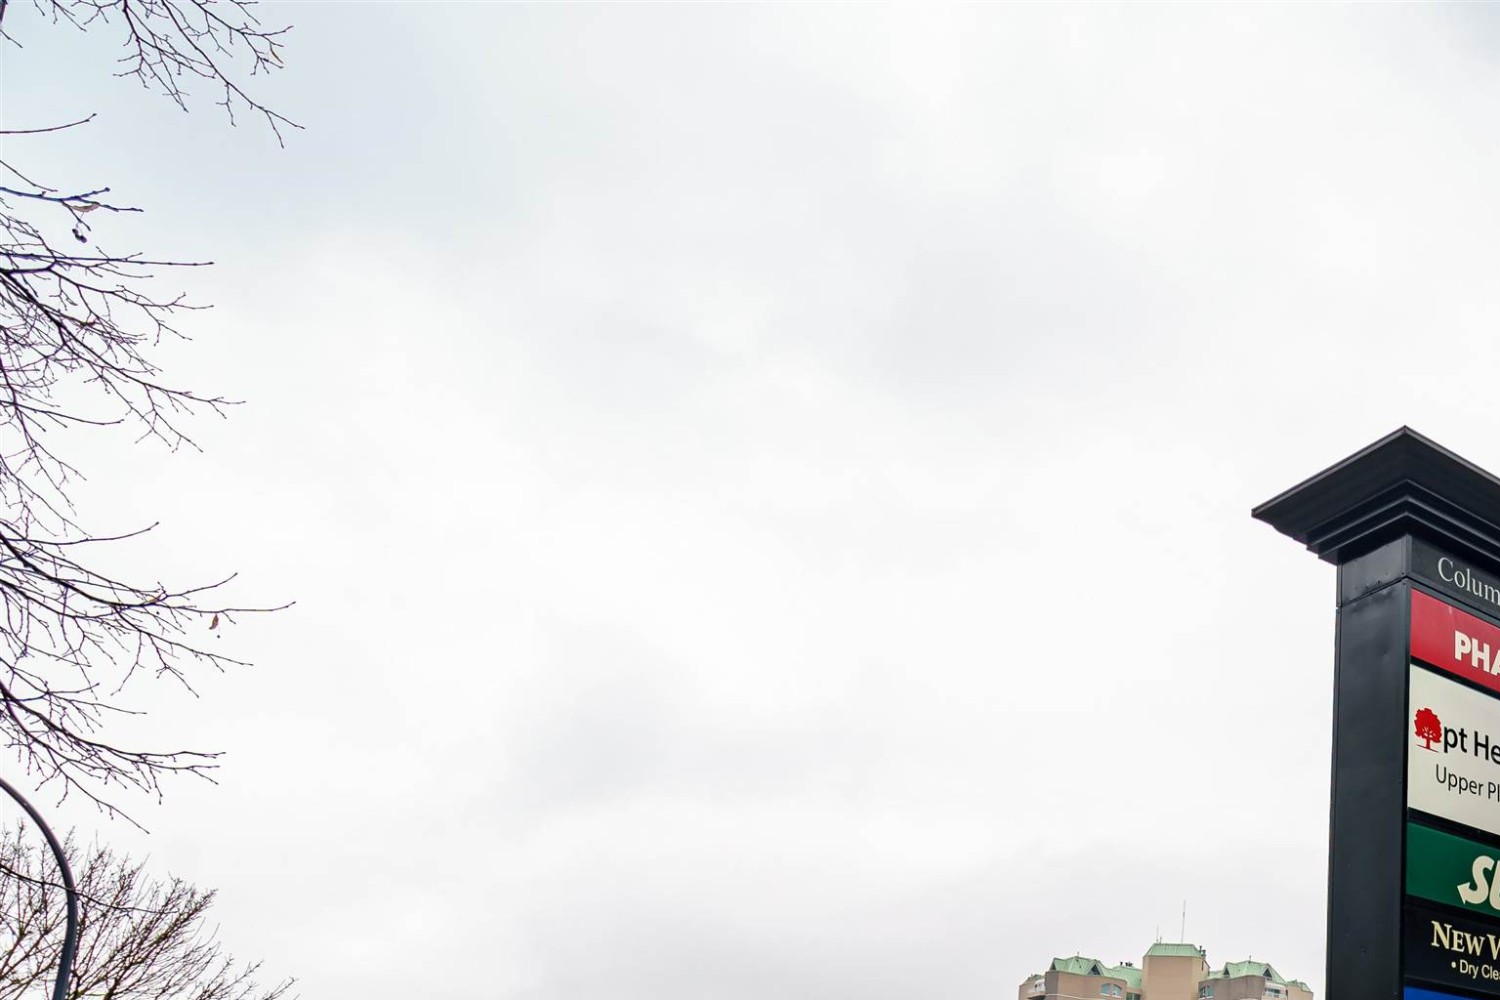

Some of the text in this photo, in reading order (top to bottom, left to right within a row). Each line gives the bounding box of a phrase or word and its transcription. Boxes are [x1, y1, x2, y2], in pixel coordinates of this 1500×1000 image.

[1443, 726, 1468, 754] pt
[1435, 763, 1484, 795] Upper
[1431, 920, 1485, 956] NEW
[1459, 959, 1479, 979] Dry
